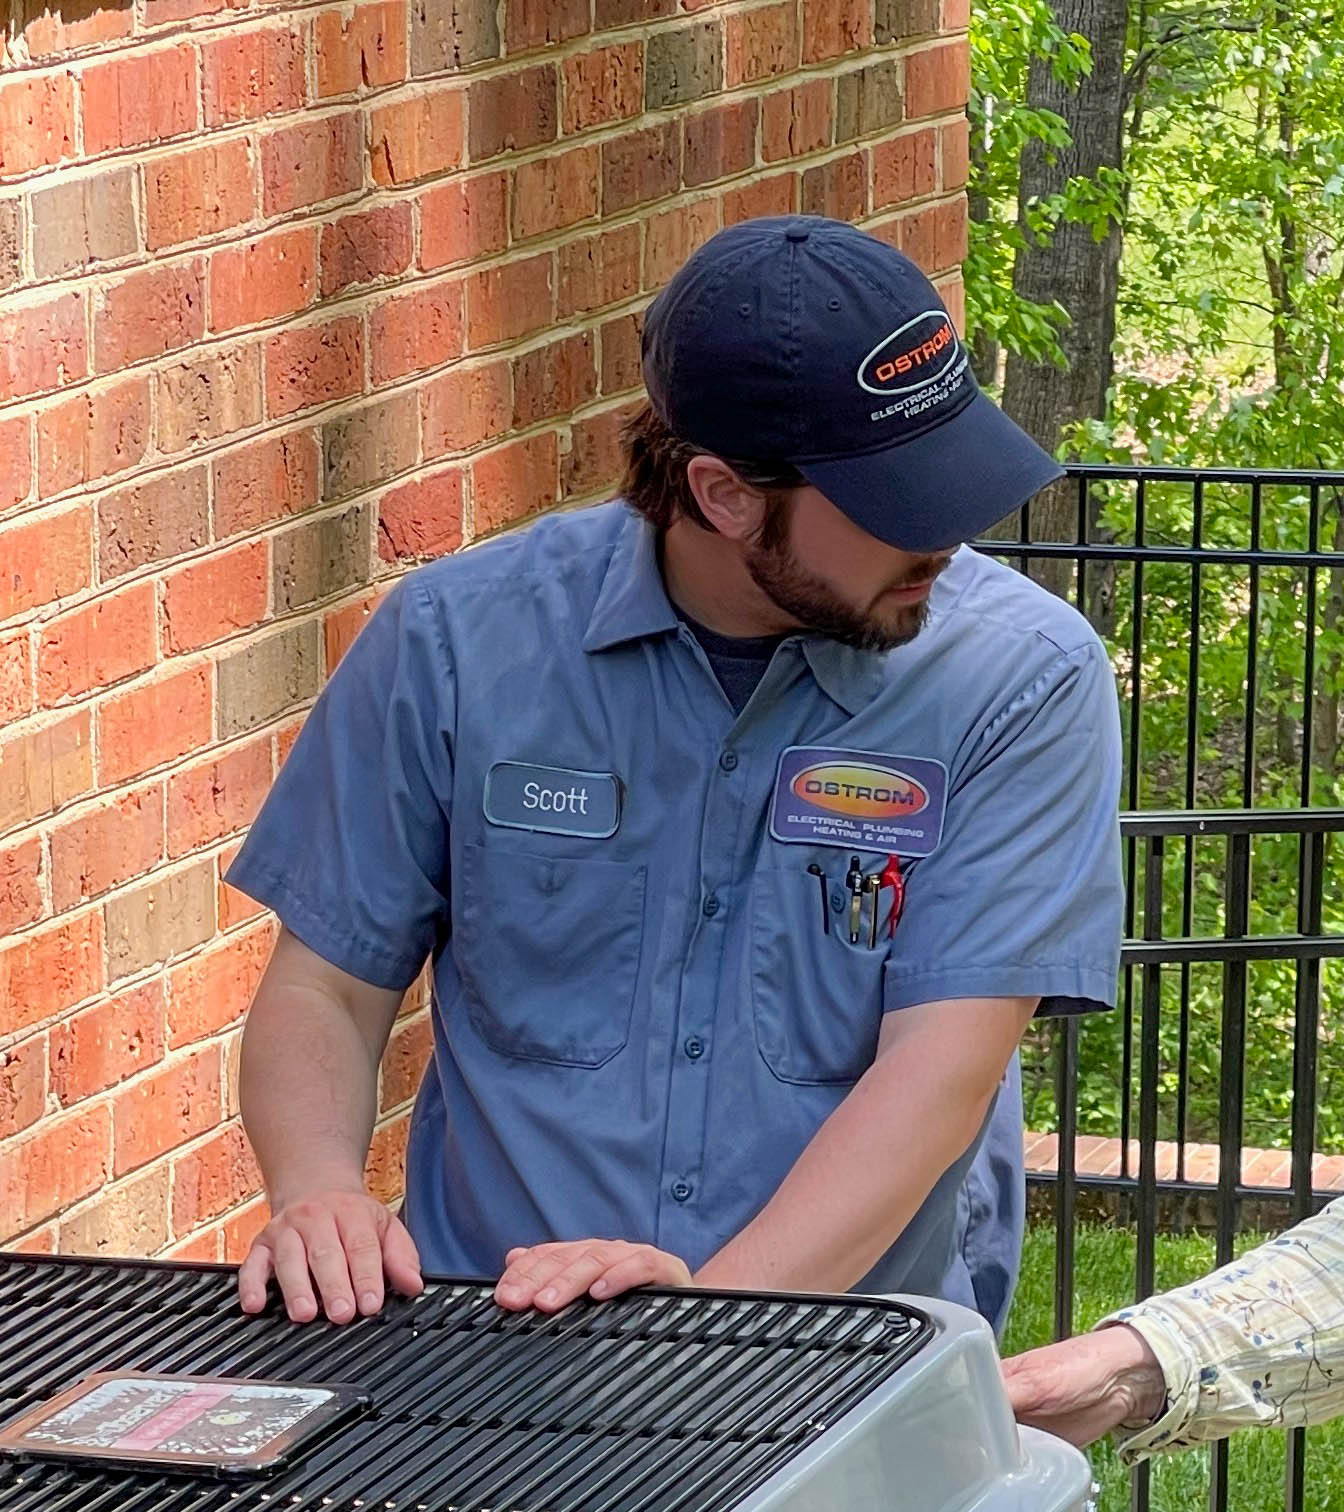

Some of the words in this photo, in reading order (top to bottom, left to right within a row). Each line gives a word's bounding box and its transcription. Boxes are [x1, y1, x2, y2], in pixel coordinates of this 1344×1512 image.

[875, 322, 953, 382] OSTROM
[870, 383, 940, 422] ELECTRICAL
[903, 388, 949, 419] HEATING
[522, 781, 589, 815] Scott
[804, 779, 915, 806] OSTROM
[786, 814, 856, 830] ELECTRICAL
[862, 822, 925, 839] PLUMBING
[812, 825, 862, 840] HEATING
[864, 831, 874, 841] &
[876, 833, 898, 845] AIR
